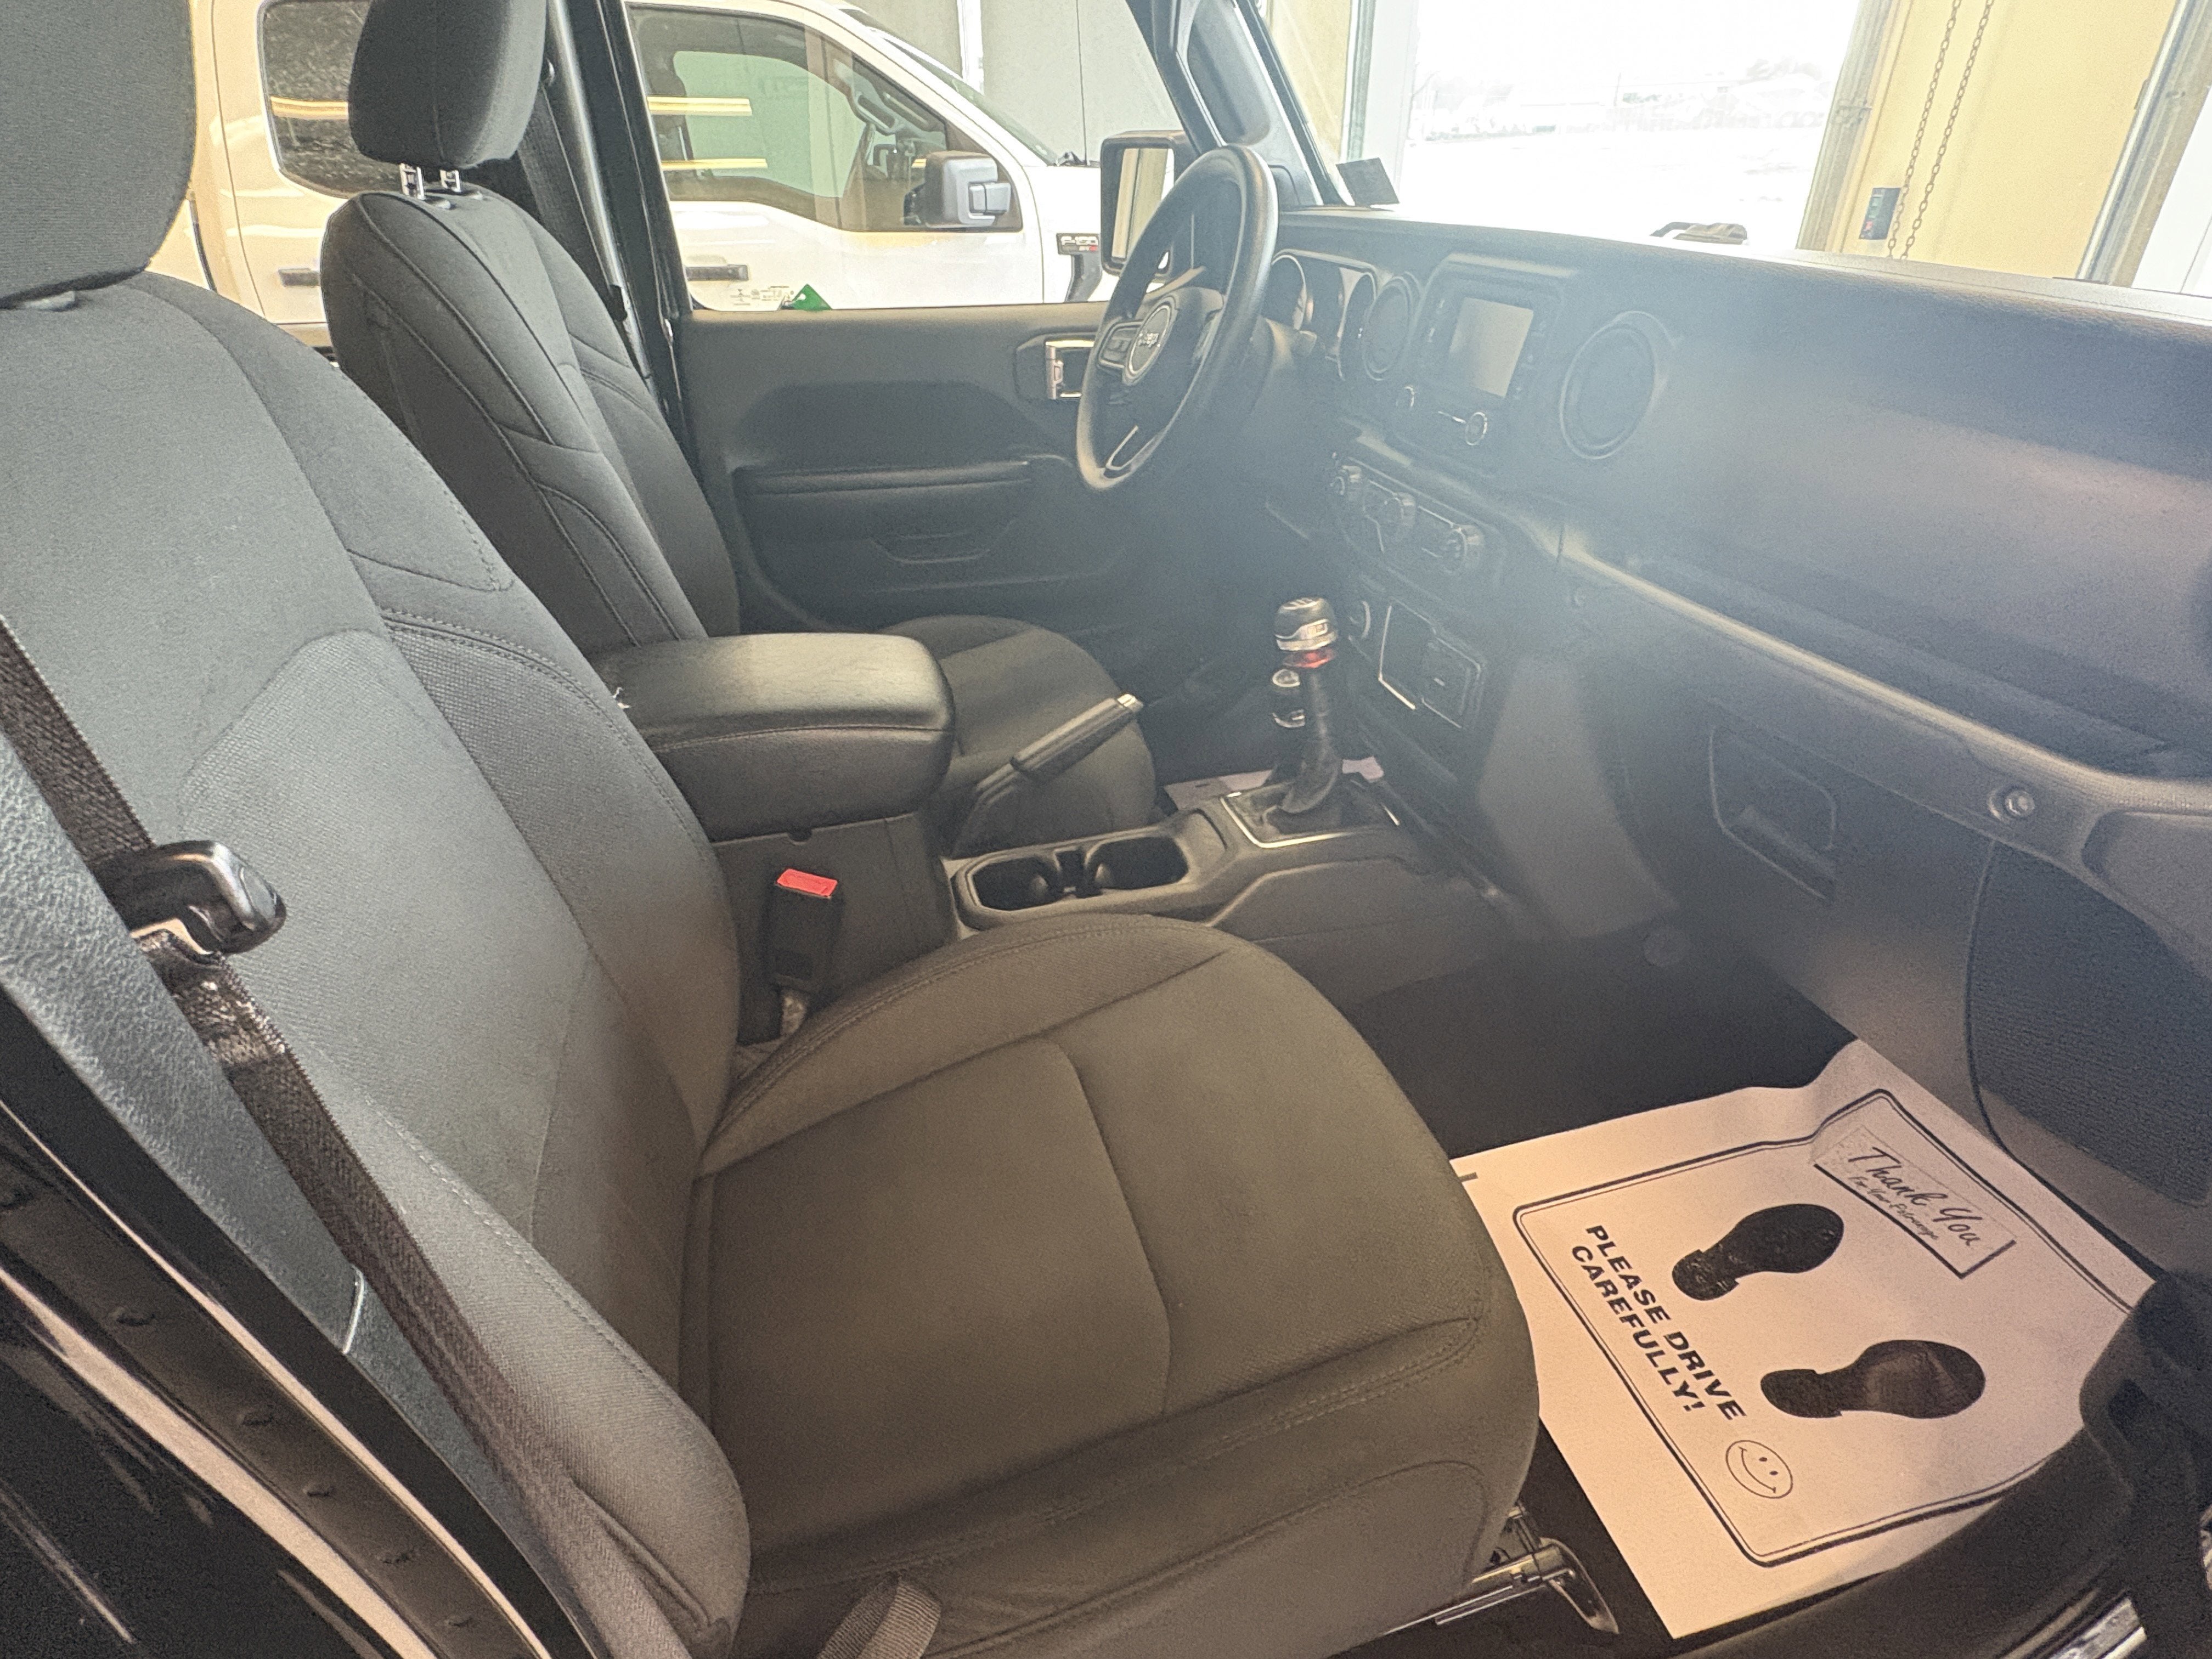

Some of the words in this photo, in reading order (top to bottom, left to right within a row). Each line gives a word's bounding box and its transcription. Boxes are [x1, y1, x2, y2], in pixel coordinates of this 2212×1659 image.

[1848, 1147, 1948, 1206] Thank
[1932, 1208, 1983, 1246] You
[1572, 1246, 1706, 1412] CAREFULLY!
[1585, 1225, 1672, 1324] PLEASE
[1663, 1331, 1747, 1420] DRIVE
